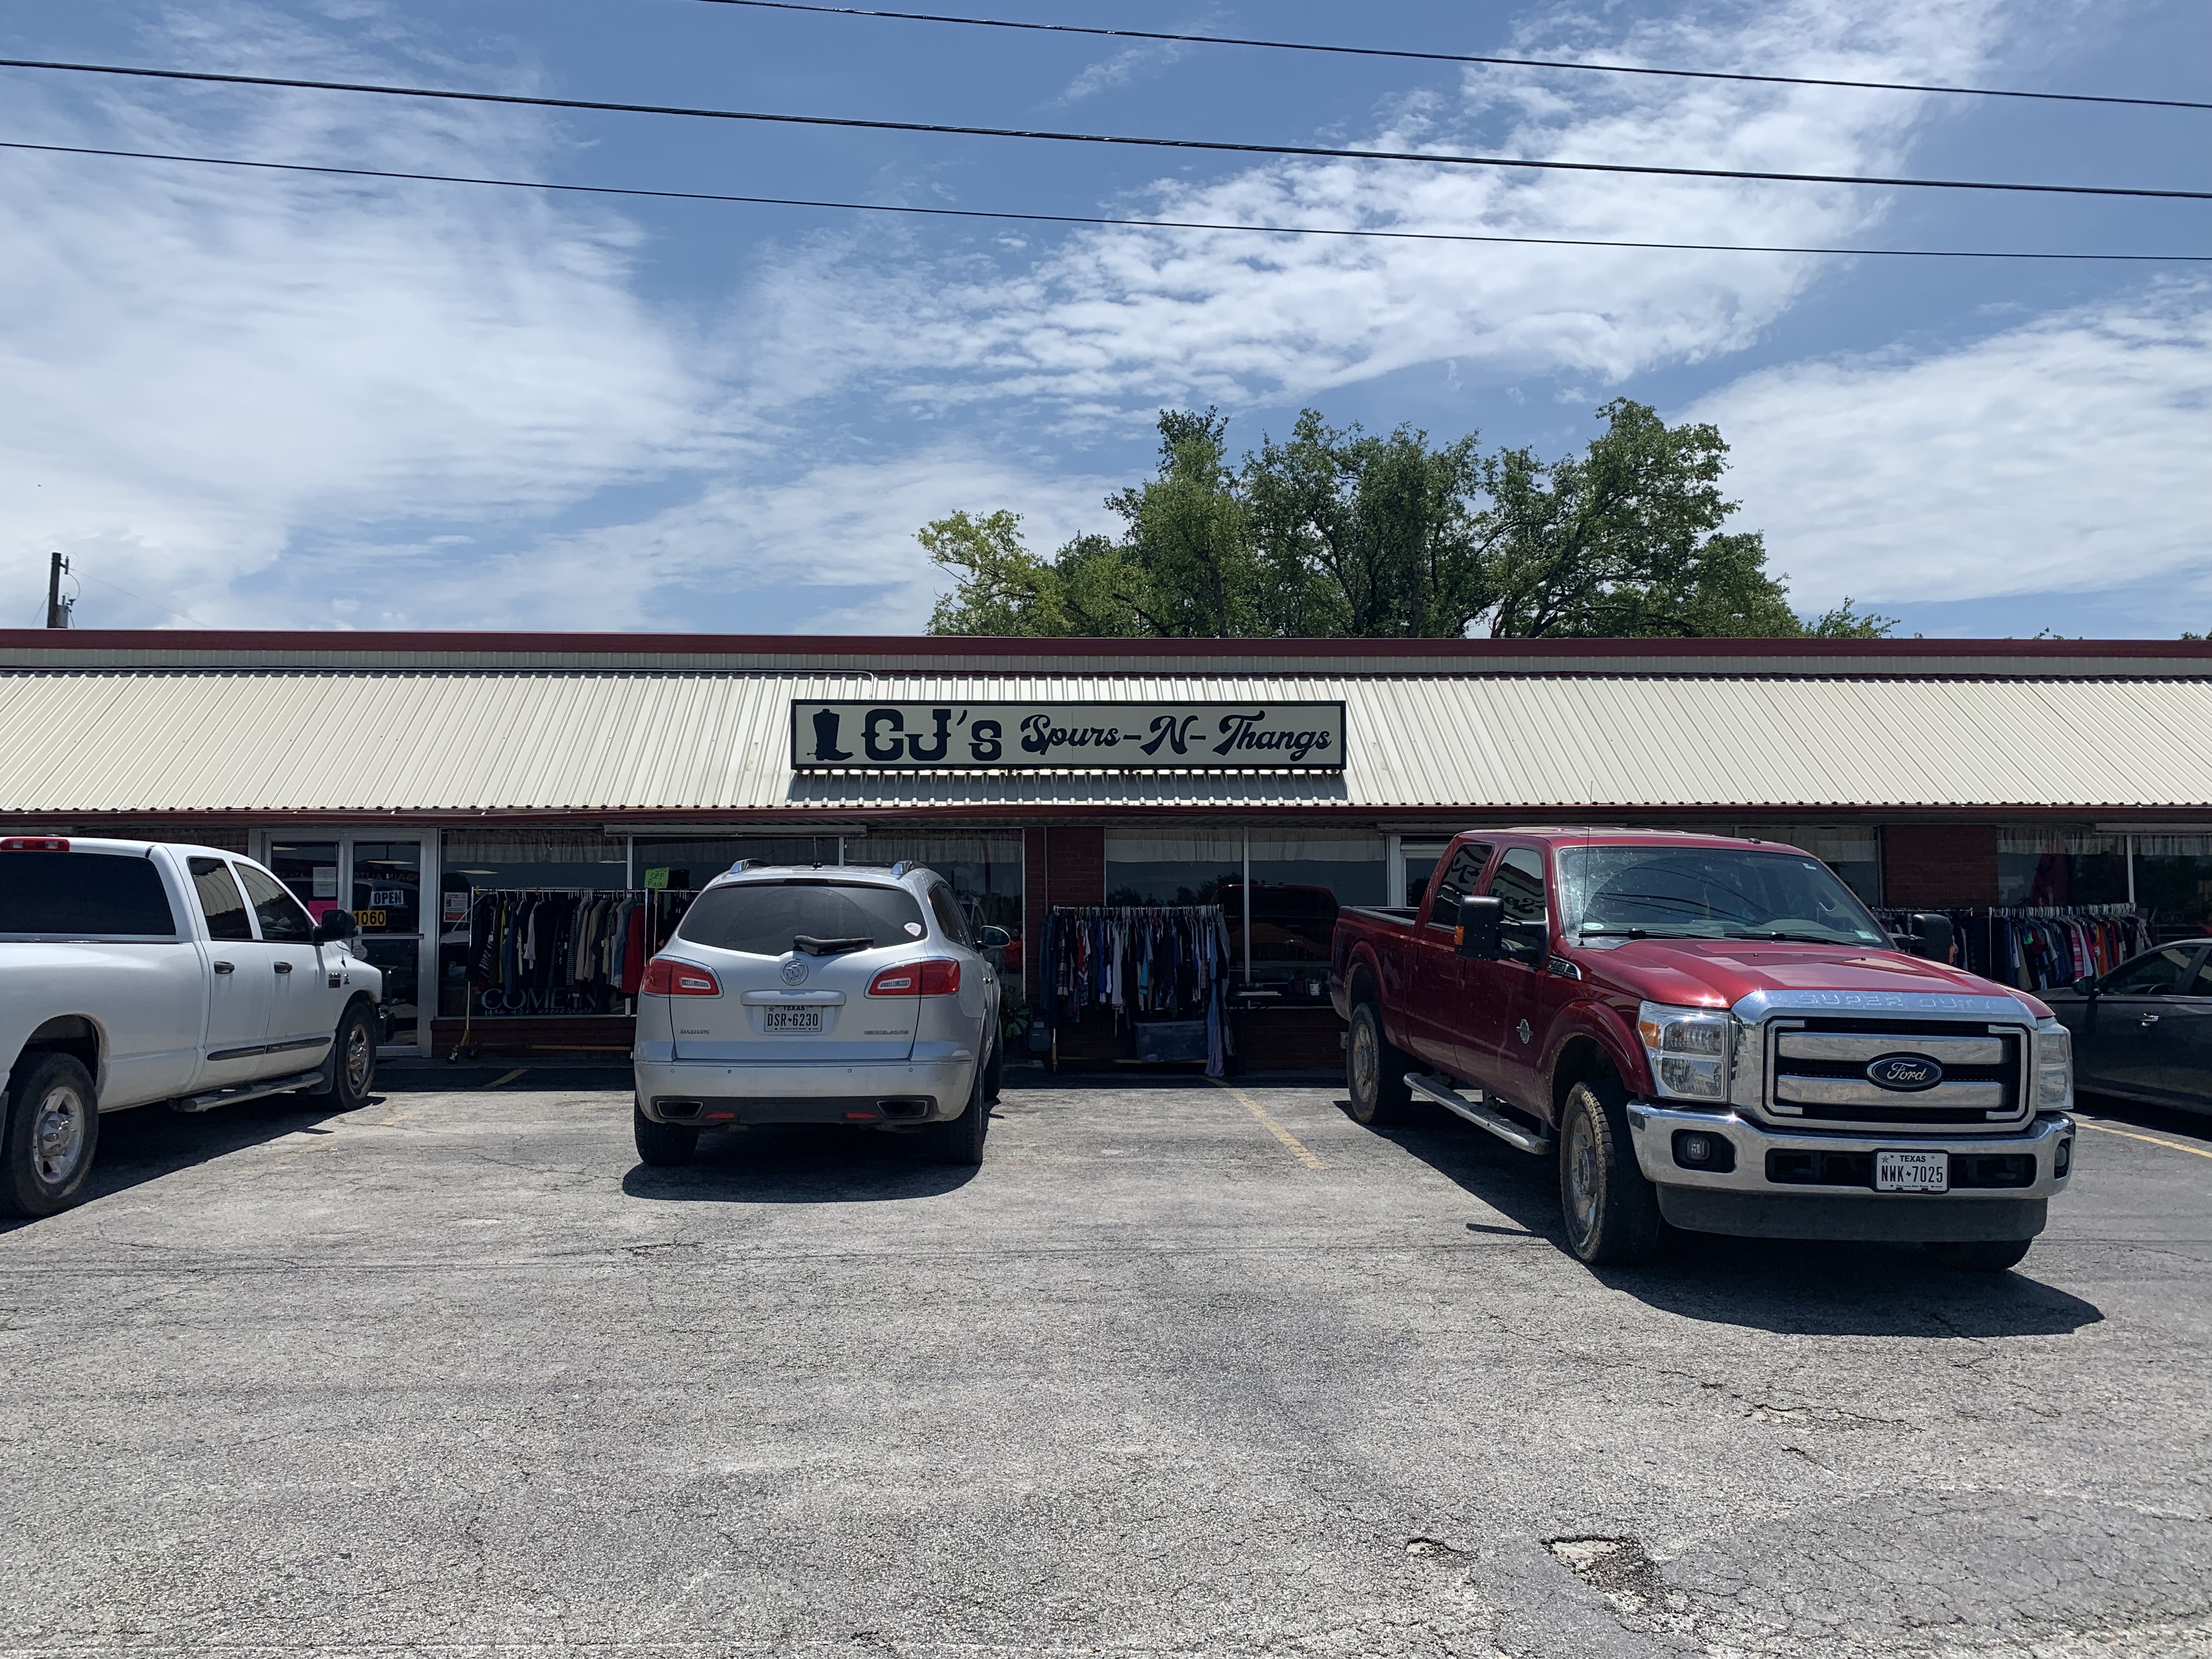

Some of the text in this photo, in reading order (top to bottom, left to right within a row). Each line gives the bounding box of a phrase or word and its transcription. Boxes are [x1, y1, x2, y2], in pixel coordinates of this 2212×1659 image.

[861, 708, 1003, 761] CJ's
[374, 891, 402, 905] OPEN
[354, 911, 385, 925] 1060
[481, 988, 567, 1009] COME
[1798, 992, 1904, 1006] SUPER
[1887, 1062, 1927, 1080] Ford
